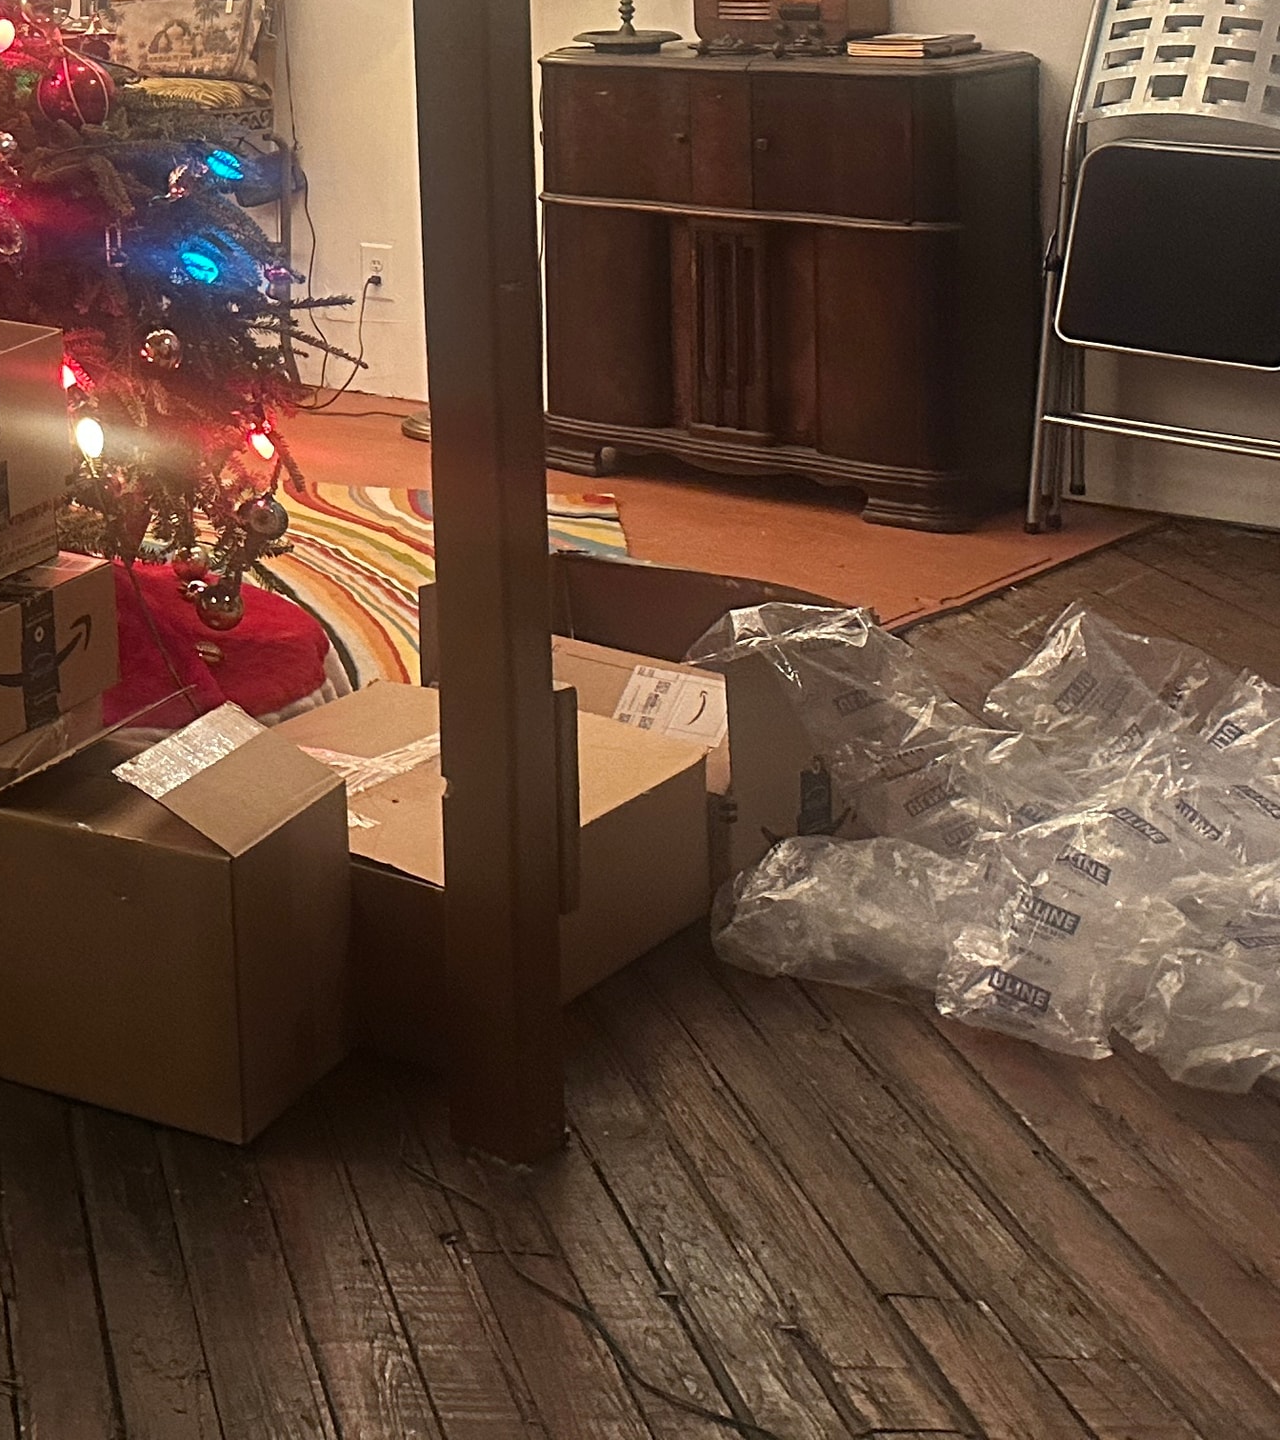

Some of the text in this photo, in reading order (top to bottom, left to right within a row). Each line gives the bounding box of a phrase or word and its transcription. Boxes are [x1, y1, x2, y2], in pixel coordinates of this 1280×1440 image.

[1209, 723, 1242, 750] ULI
[1117, 807, 1166, 843] ULINE
[991, 968, 1051, 1009] ULINE
